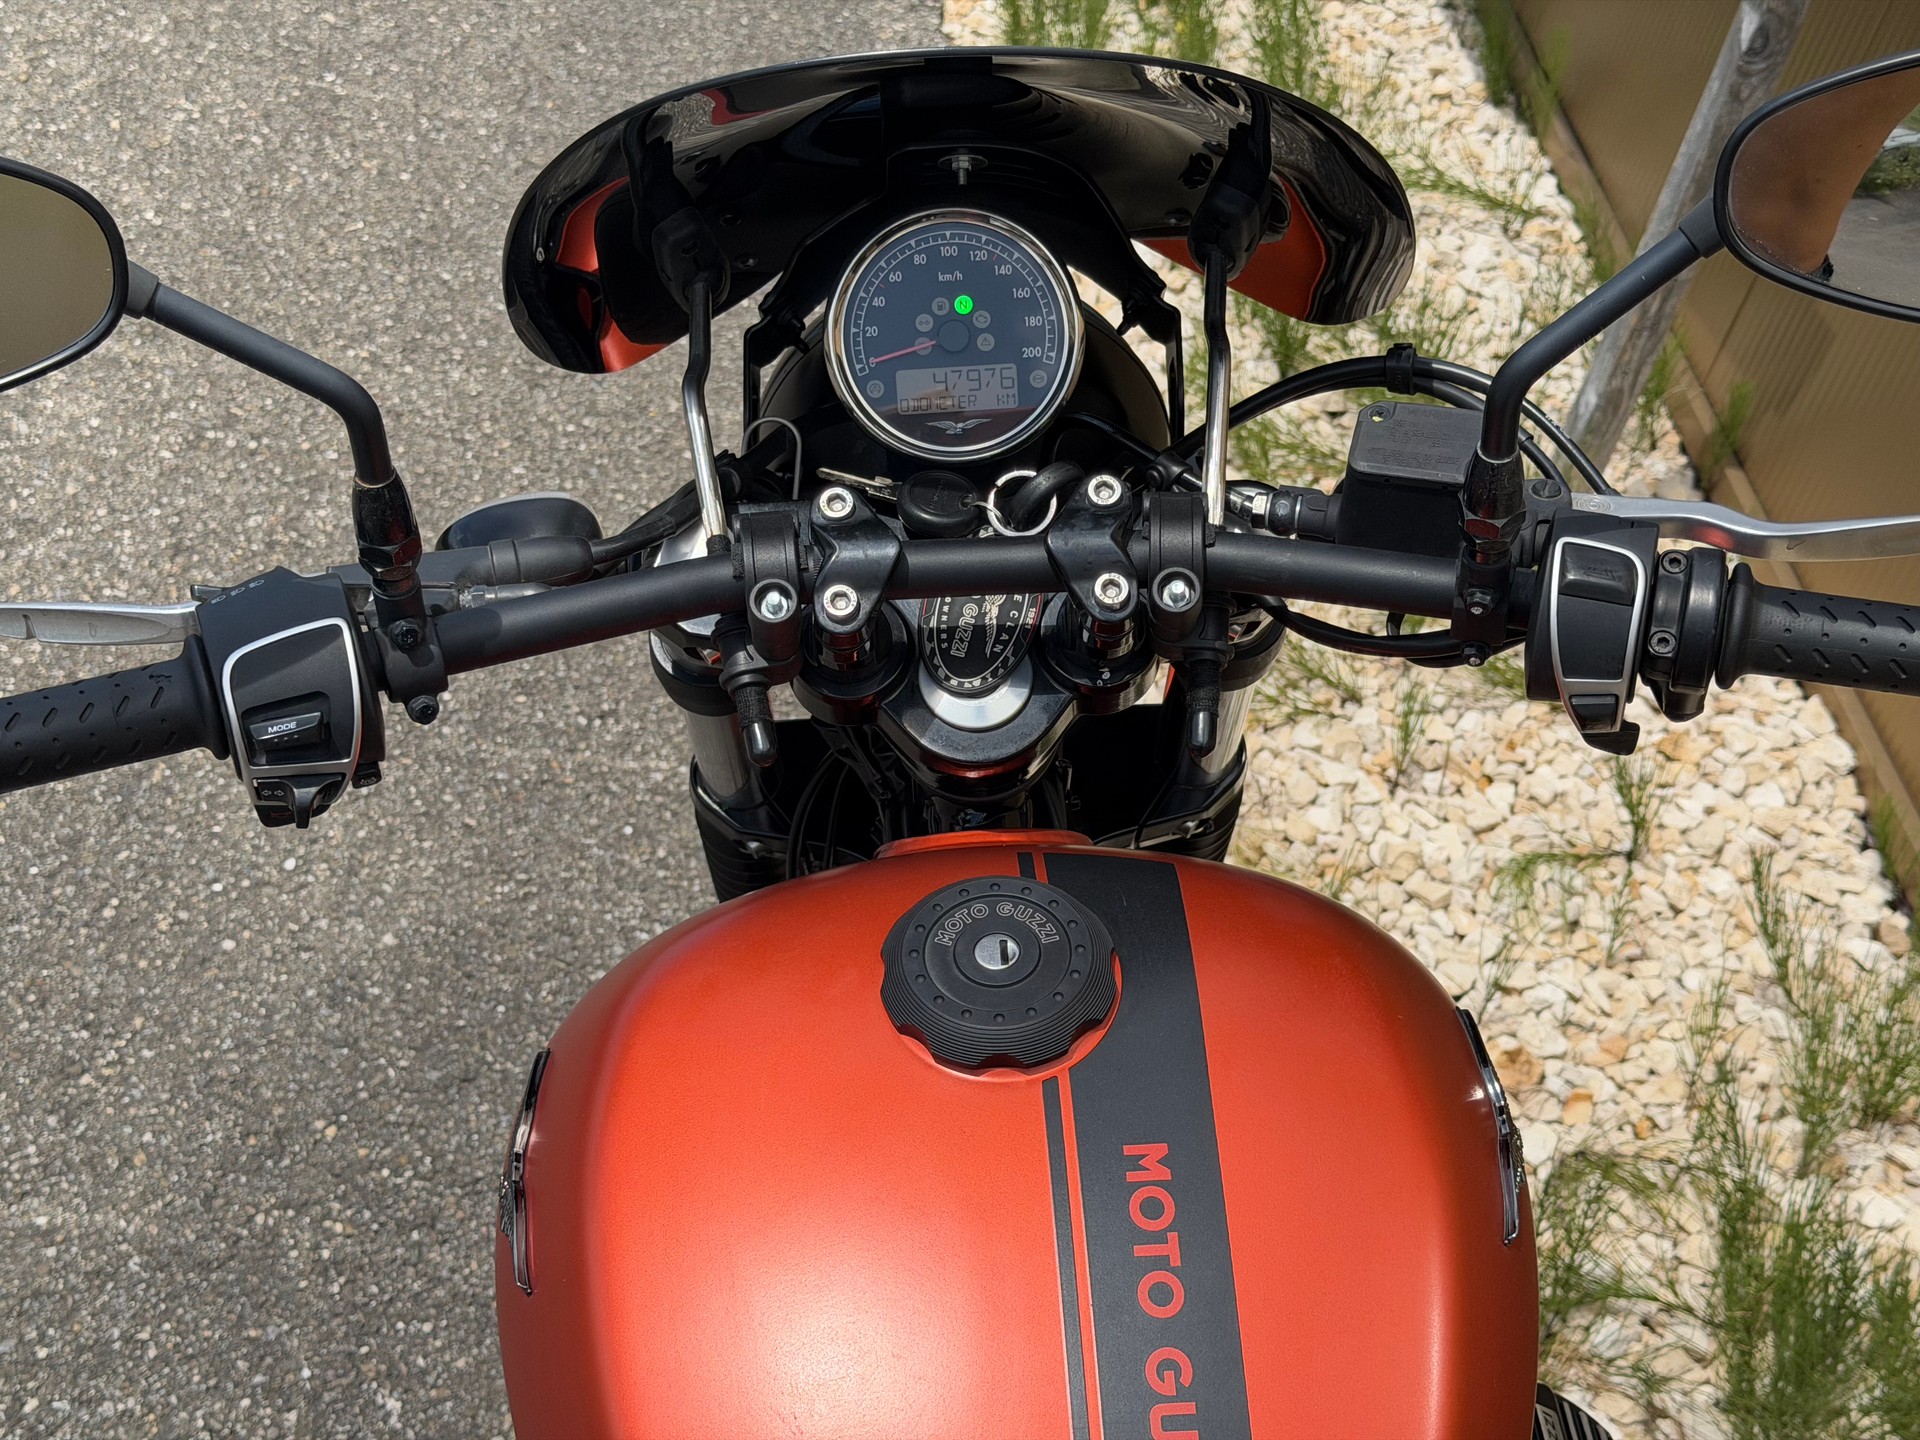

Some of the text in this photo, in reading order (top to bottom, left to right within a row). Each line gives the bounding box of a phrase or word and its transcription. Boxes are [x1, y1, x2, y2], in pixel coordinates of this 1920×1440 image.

[940, 246, 958, 257] 100
[969, 250, 988, 261] 120
[913, 254, 927, 265] 80
[994, 264, 1013, 276] 140
[889, 271, 902, 283] 60
[938, 271, 963, 282] km/h
[1012, 287, 1031, 299] 160
[872, 296, 885, 307] 40
[1024, 316, 1042, 327] 180
[865, 326, 878, 337] 20
[1021, 347, 1042, 358] 200
[933, 366, 1016, 392] 47976
[900, 394, 1017, 413] ODOMETER KM
[940, 596, 952, 650] OWNERS
[1025, 607, 1037, 629] 1921
[951, 603, 979, 658] GUZZI
[992, 610, 1018, 653] CLAN
[267, 721, 297, 734] MODE
[934, 901, 1060, 947] MOTO GUZZI
[1122, 1143, 1185, 1319] MOTO
